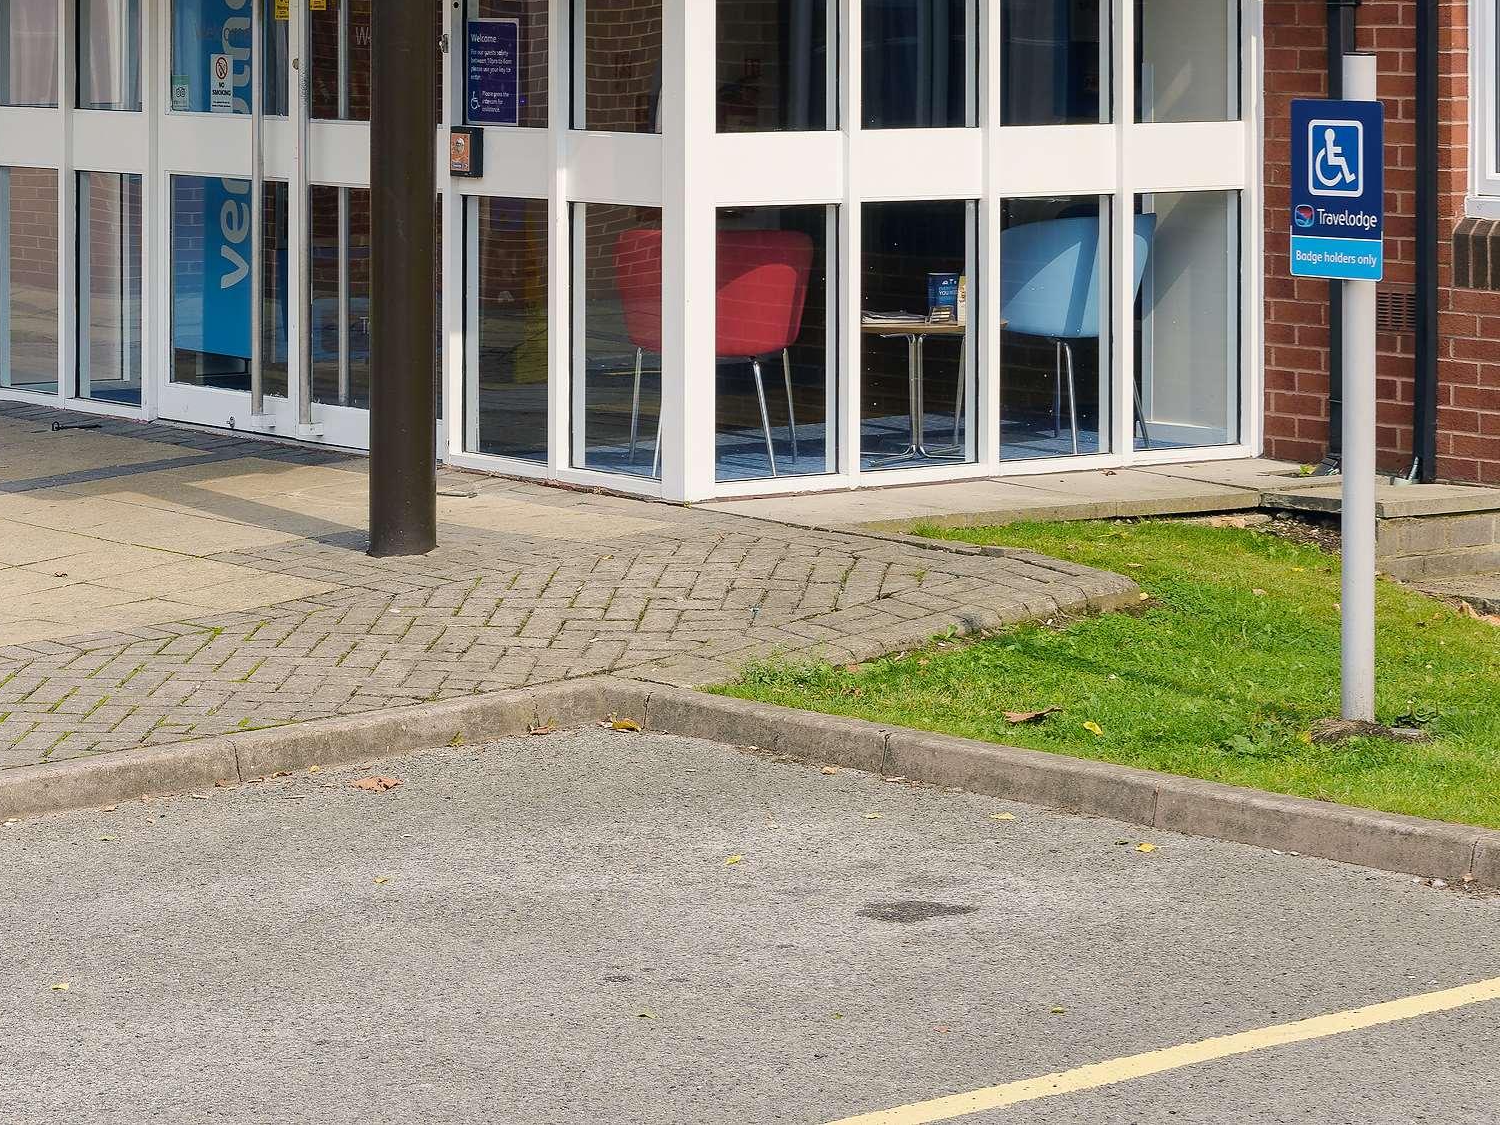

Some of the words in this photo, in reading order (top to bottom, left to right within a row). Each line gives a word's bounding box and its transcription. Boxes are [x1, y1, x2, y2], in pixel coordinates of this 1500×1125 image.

[470, 33, 498, 43] Welcome
[1316, 208, 1378, 231] Travelodge
[1295, 249, 1323, 264] Badge
[1324, 251, 1356, 264] holders
[1357, 254, 1377, 268] only
